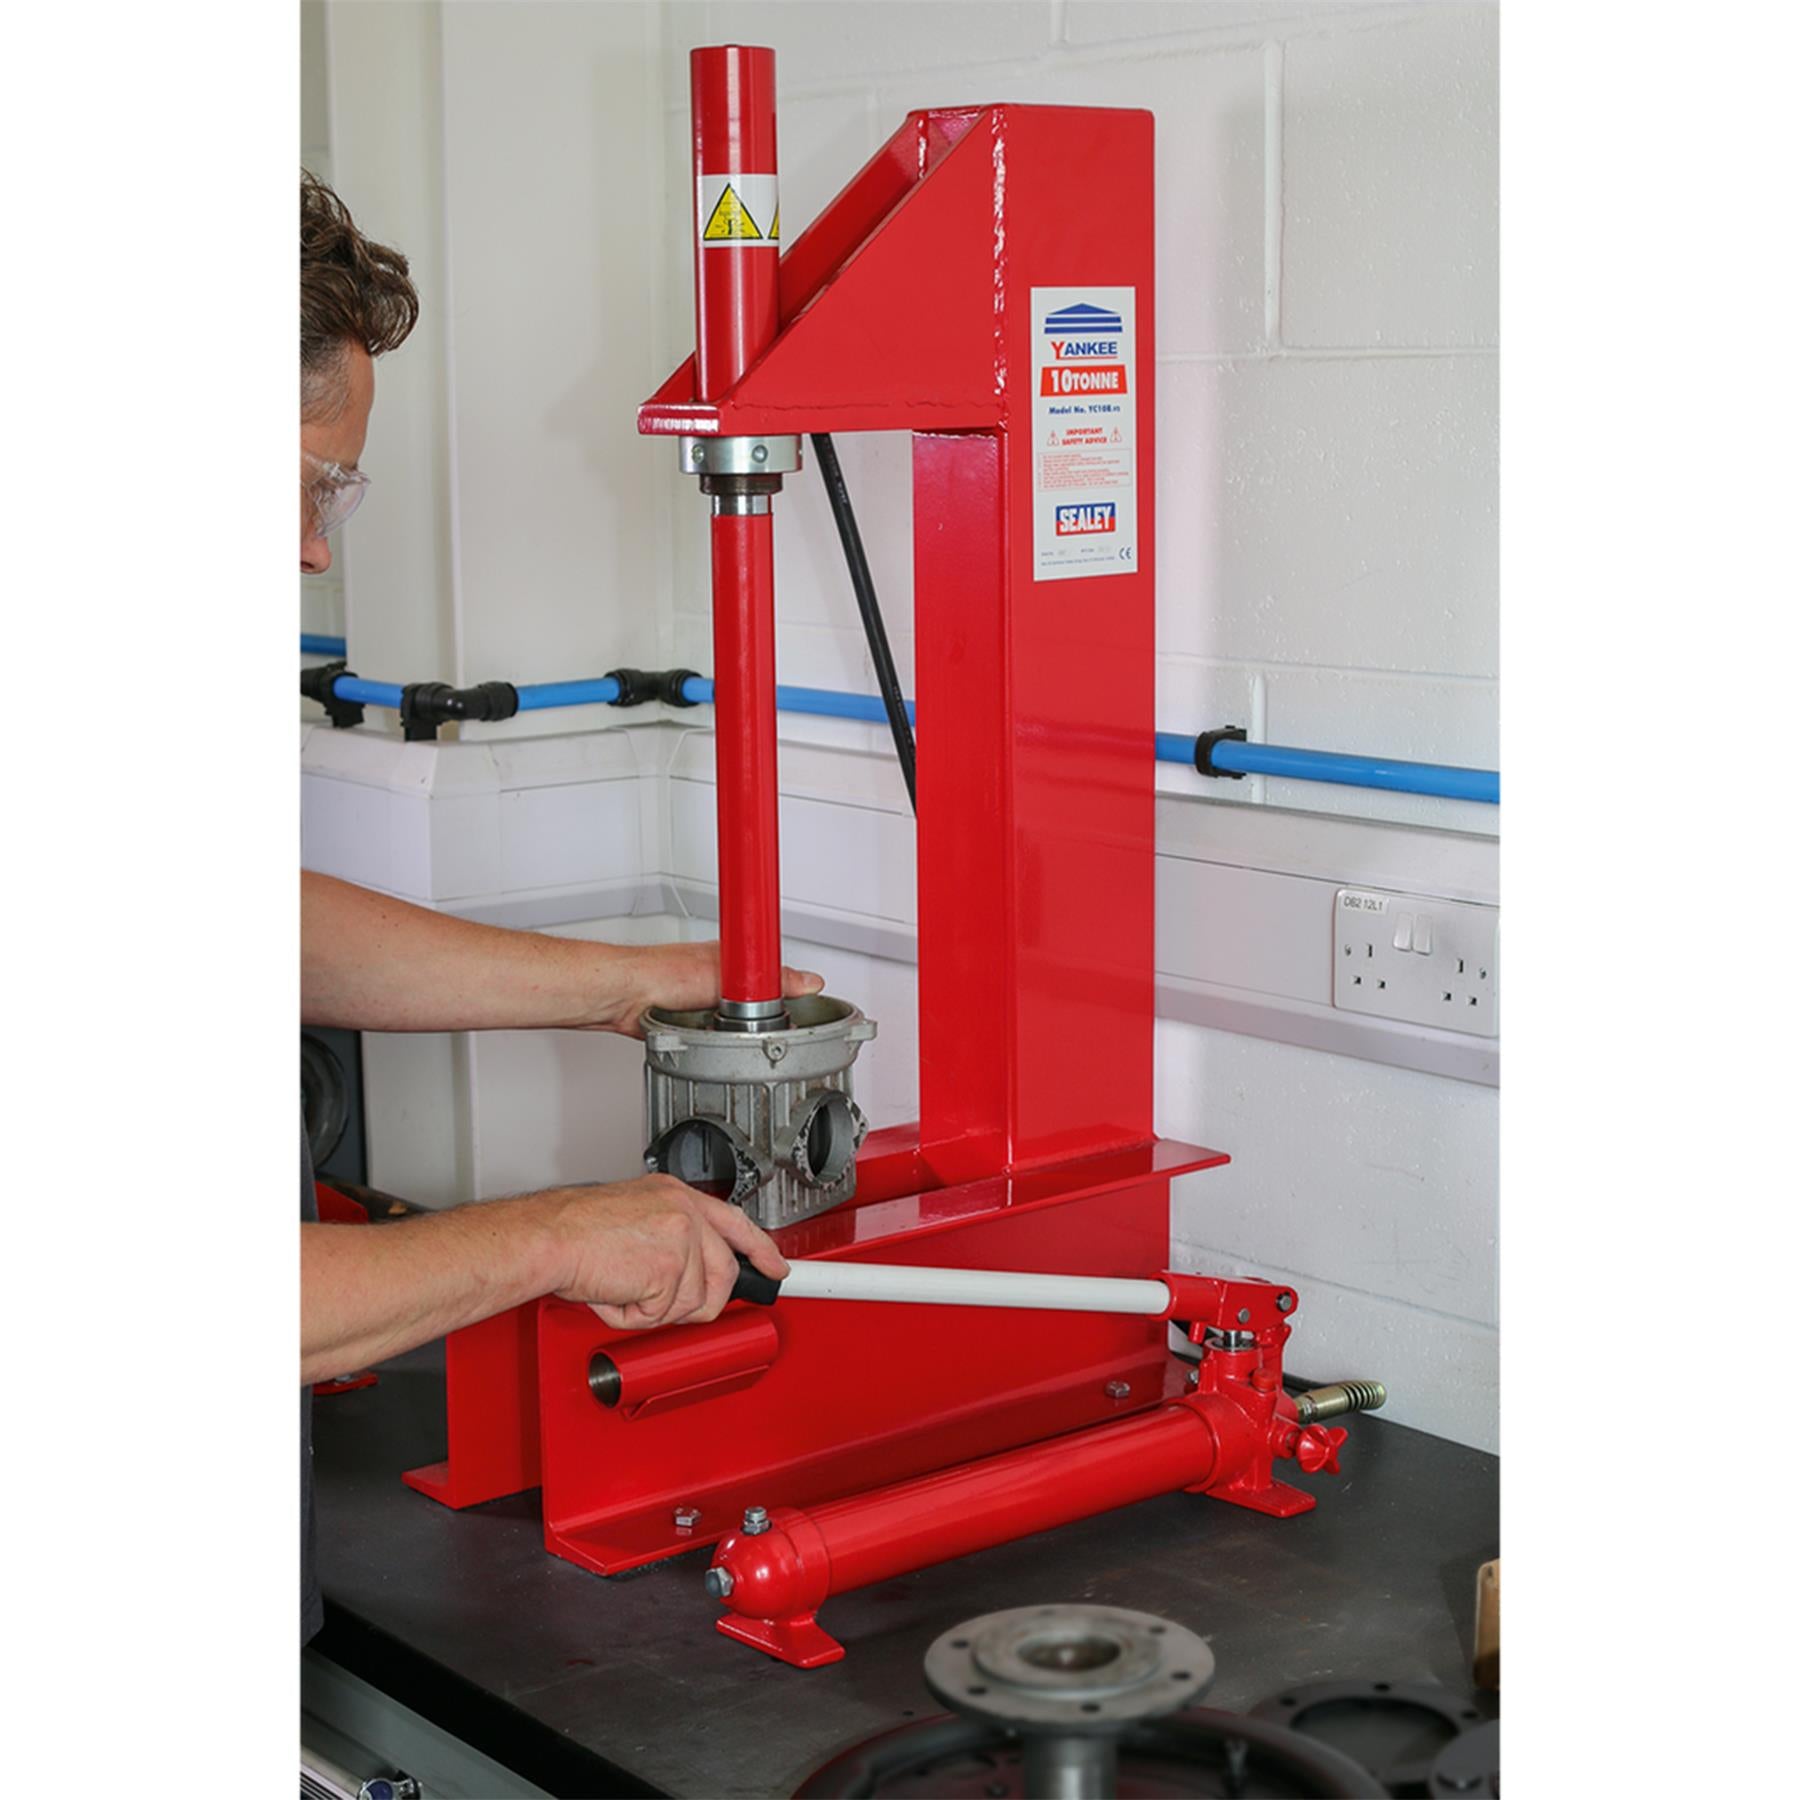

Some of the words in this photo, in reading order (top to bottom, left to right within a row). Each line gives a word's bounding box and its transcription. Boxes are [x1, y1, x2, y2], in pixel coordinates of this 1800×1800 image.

[1051, 341, 1117, 360] YANKEE
[1049, 406, 1072, 414] Model
[1066, 428, 1103, 436] IMPORTANT
[1062, 438, 1083, 446] SAFETY
[1085, 437, 1107, 445] ADVICE
[1059, 505, 1112, 532] SEALEY
